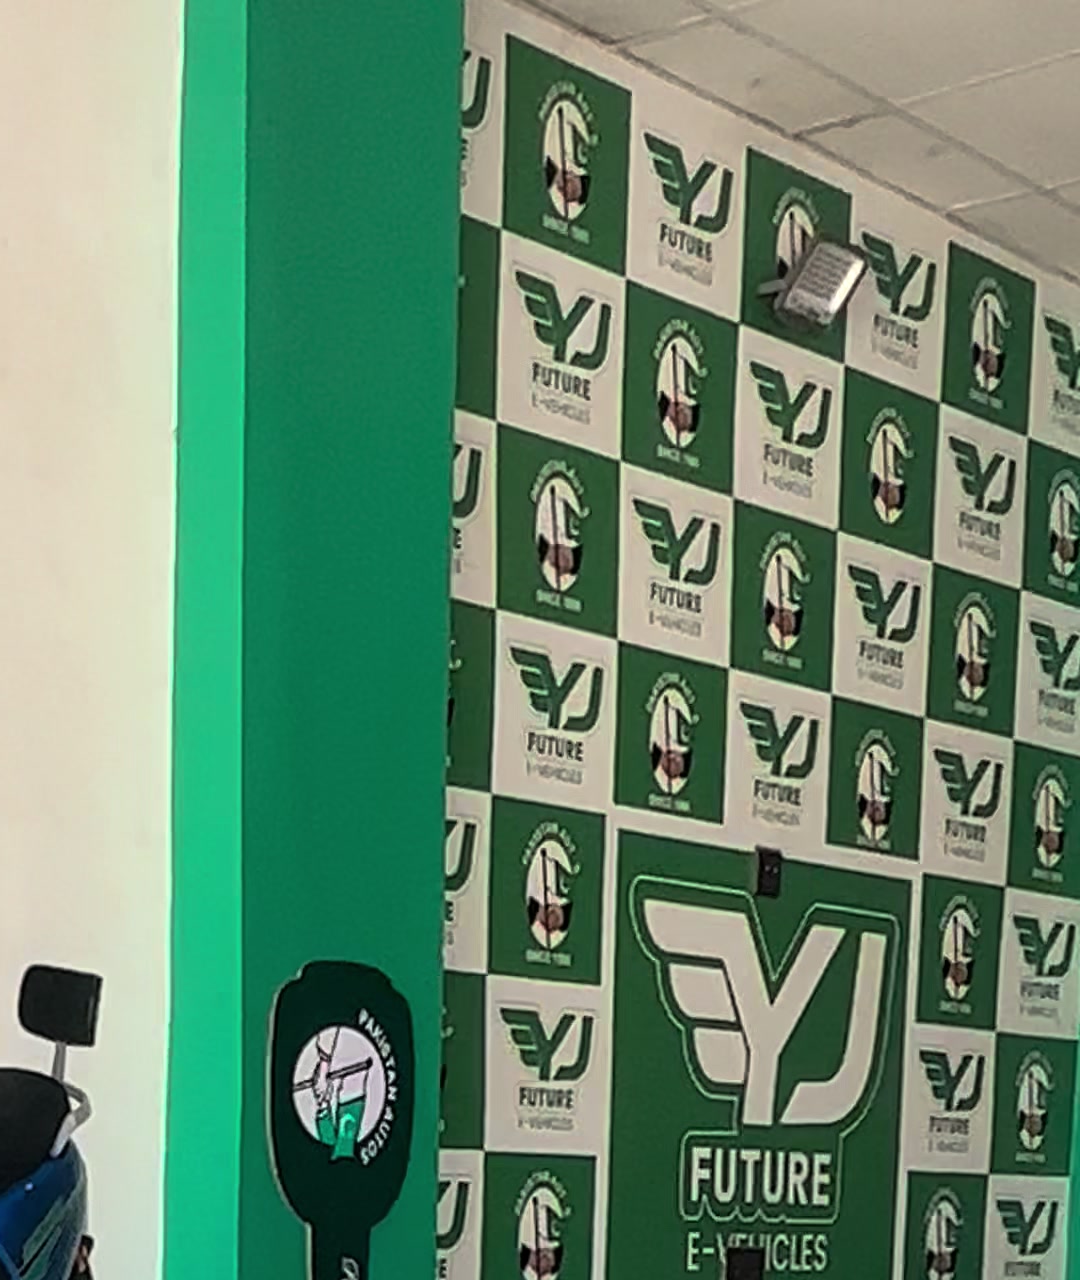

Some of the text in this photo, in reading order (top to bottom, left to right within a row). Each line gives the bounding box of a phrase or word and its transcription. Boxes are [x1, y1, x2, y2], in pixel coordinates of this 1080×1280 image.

[660, 223, 712, 262] FUTURE
[532, 362, 591, 401] FUTURE
[764, 444, 813, 477] FUTURE
[650, 582, 702, 614] FUTURE
[527, 732, 584, 762] FUTURE
[754, 779, 801, 806] FUTURE
[358, 1008, 397, 1166] PAKISTAN AUTOS
[519, 1086, 574, 1110] FUTURE
[691, 1147, 831, 1207] FUTURE
